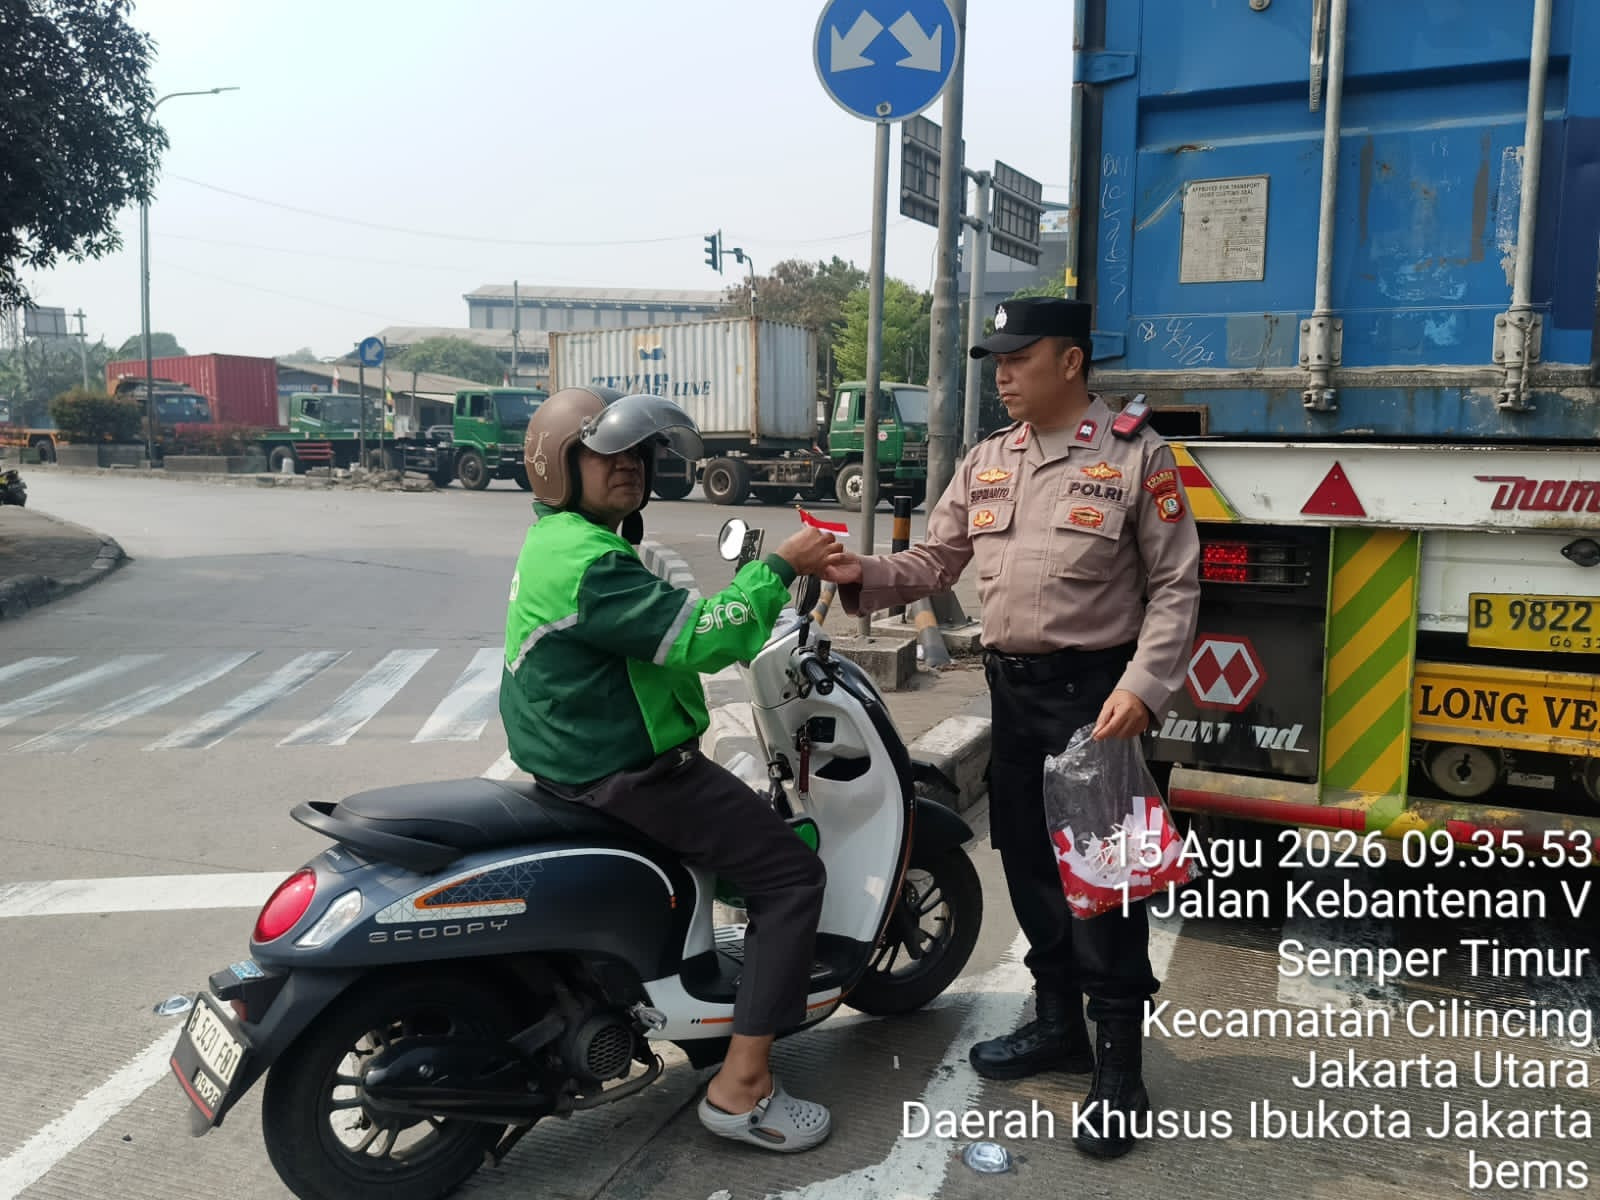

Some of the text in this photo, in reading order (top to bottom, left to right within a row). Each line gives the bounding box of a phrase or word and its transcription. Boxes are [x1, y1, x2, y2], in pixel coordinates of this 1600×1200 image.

[673, 381, 711, 396] LINE
[1069, 482, 1123, 501] POLRI
[695, 592, 757, 634] Gra
[1474, 598, 1593, 632] B 9822
[1418, 684, 1600, 732] LONG VE
[368, 919, 508, 943] SCOOPY
[189, 1007, 201, 1033] B
